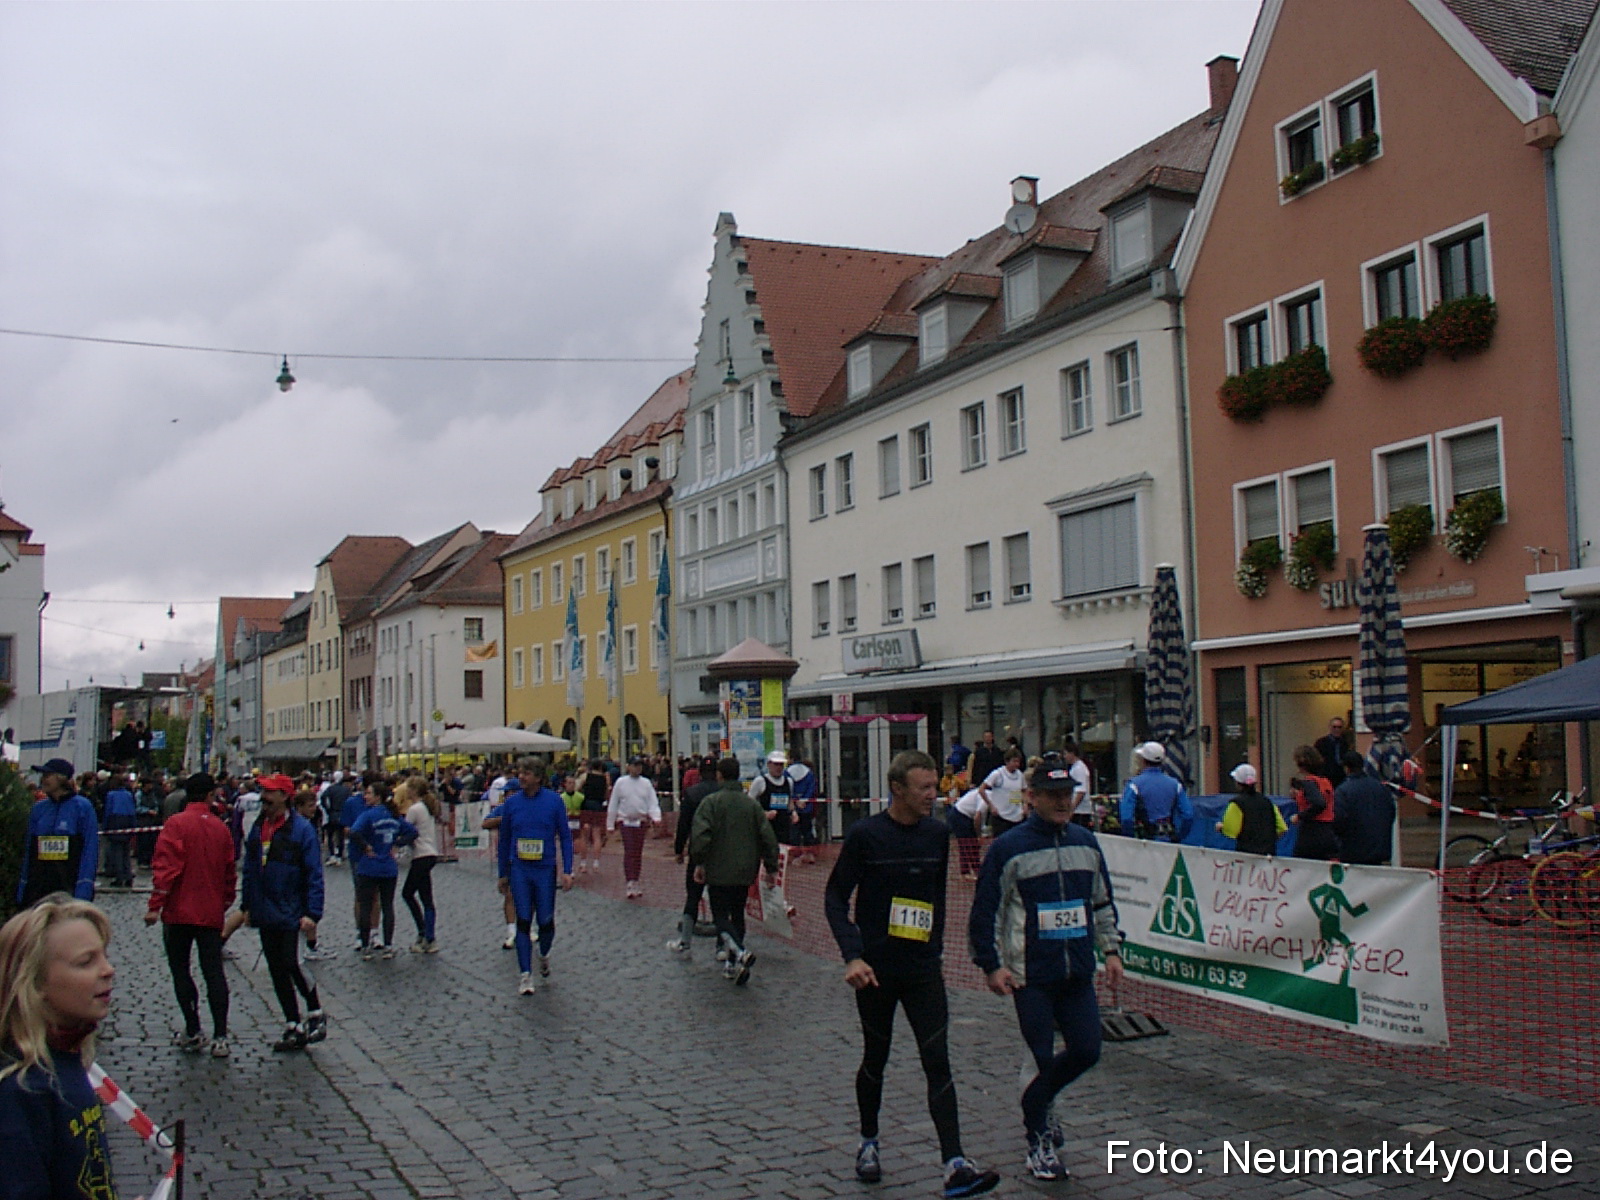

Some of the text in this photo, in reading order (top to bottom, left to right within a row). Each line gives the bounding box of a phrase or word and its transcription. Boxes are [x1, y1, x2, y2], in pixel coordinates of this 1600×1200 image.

[852, 636, 902, 660] Carlson
[1249, 864, 1292, 895] UNS
[901, 908, 930, 929] 1186
[1055, 910, 1078, 928] 524
[1208, 967, 1227, 985] 63
[1228, 969, 1247, 989] 52
